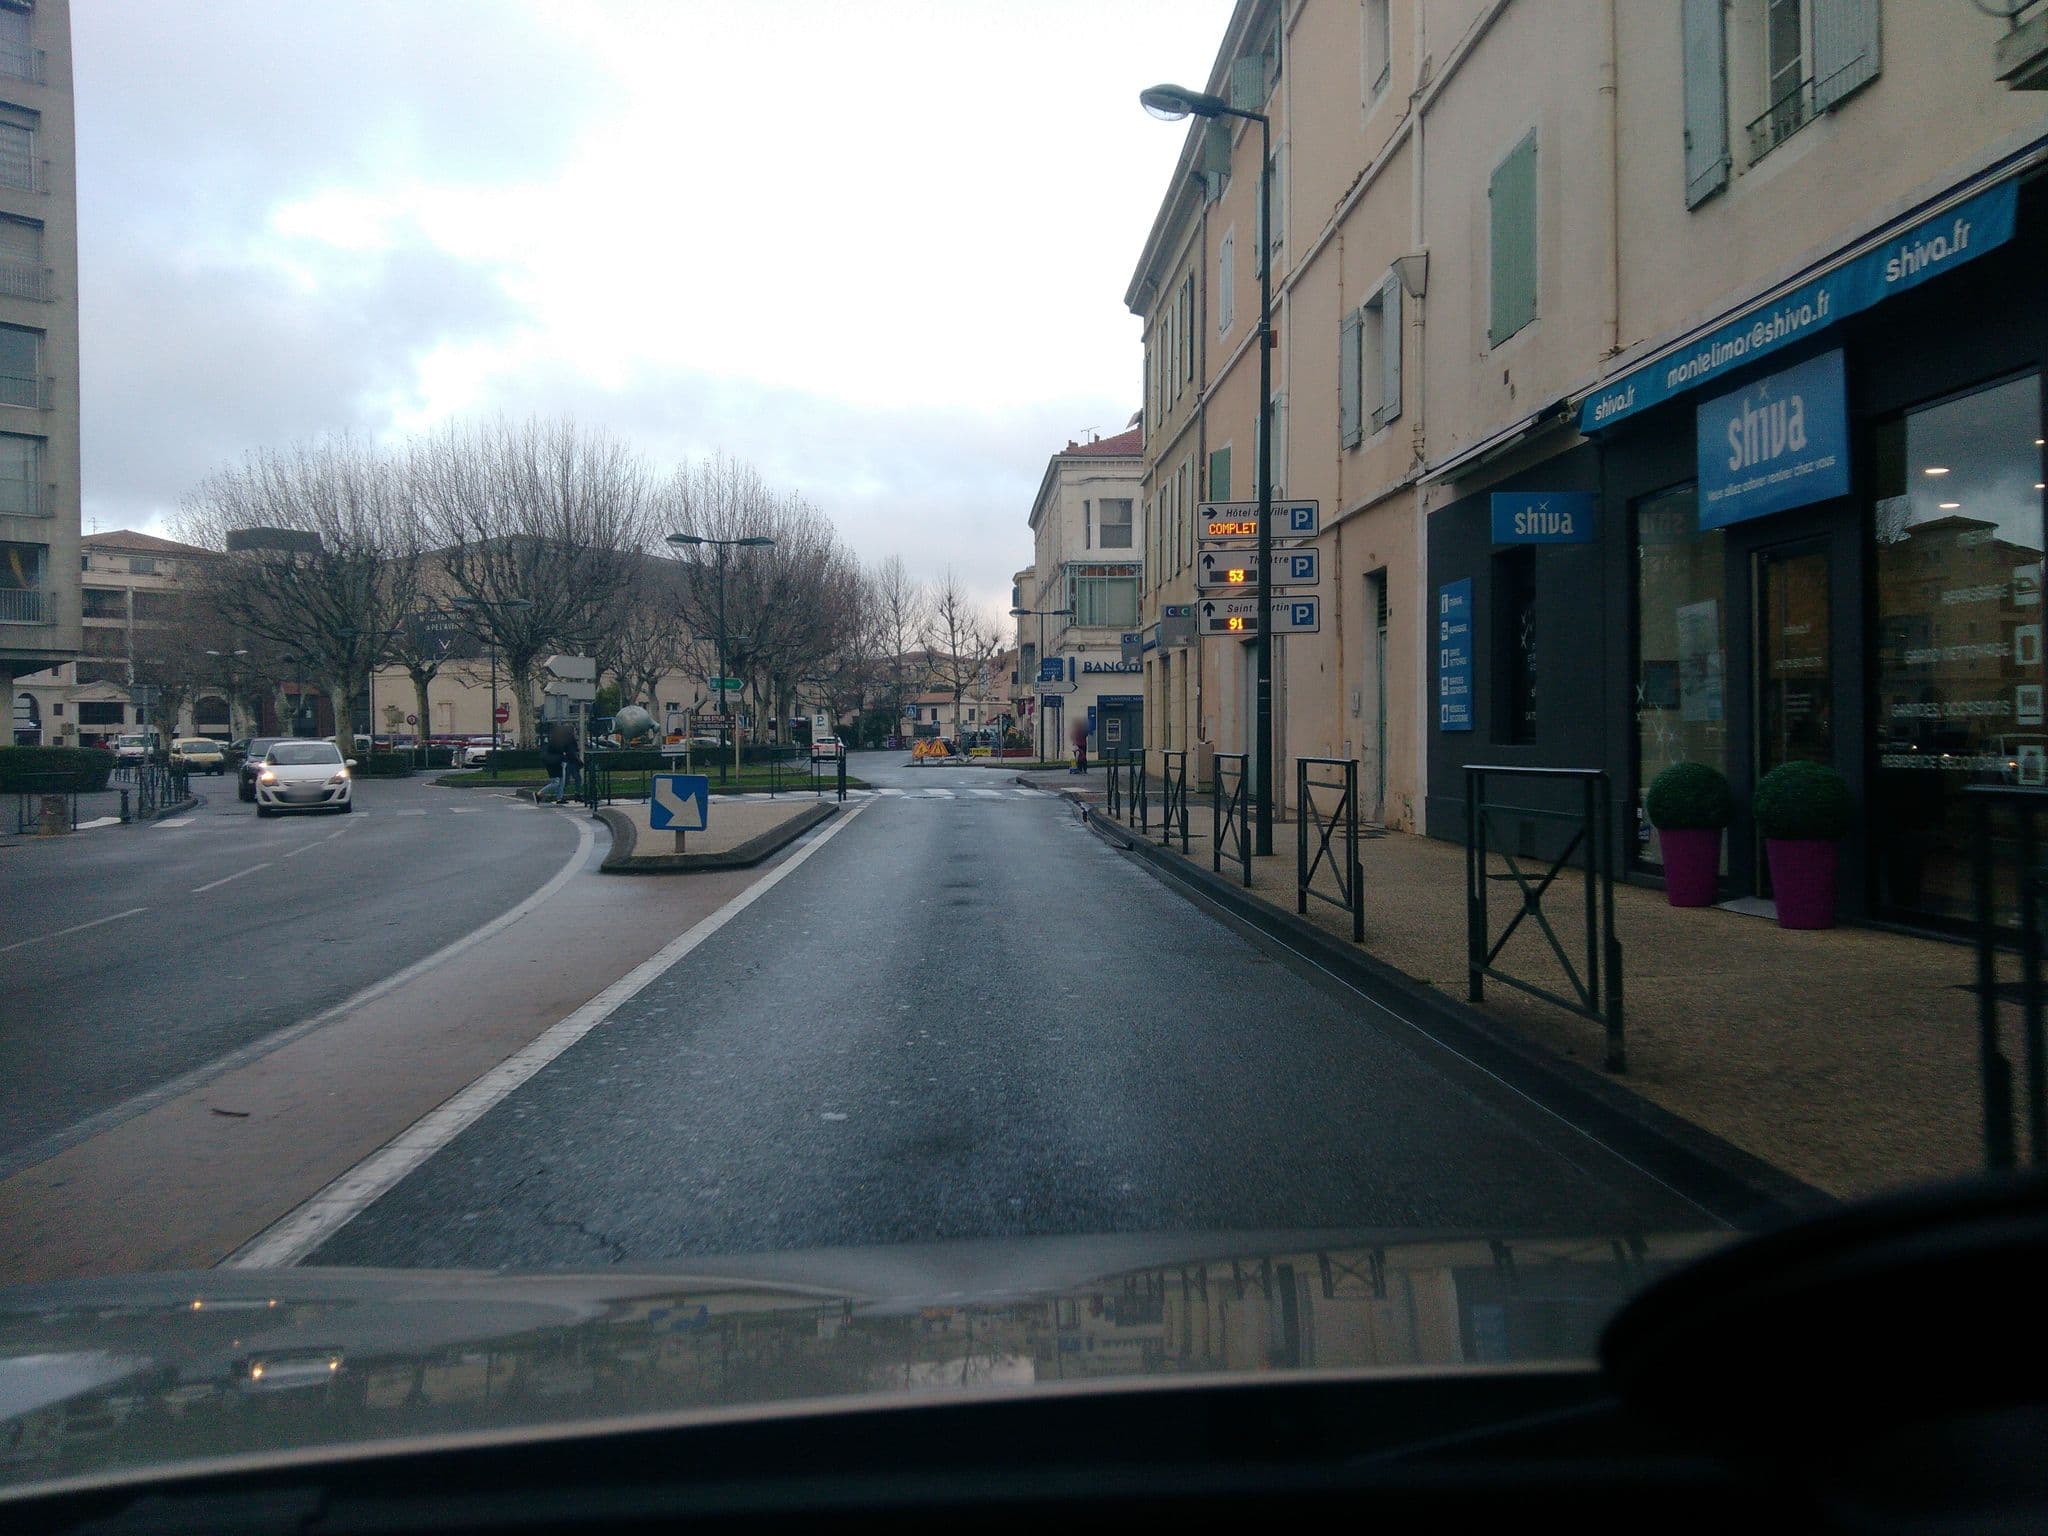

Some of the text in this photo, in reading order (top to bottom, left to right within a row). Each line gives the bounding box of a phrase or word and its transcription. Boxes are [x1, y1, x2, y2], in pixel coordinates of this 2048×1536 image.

[1885, 218, 1971, 282] shiva.fr
[1667, 288, 1831, 388] montelimar@shiva.fr
[1595, 384, 1635, 421] shiva.fr
[1727, 390, 1808, 471] shiva
[1226, 507, 1250, 518] Hôtel
[1295, 510, 1309, 529] P
[1514, 506, 1574, 535] shiva
[1209, 522, 1257, 535] COMPLET
[1249, 555, 1289, 565] Thtre
[1295, 558, 1309, 577] P
[1228, 568, 1245, 582] 53
[1227, 604, 1253, 613] Saint
[1296, 606, 1309, 625] P
[1229, 617, 1244, 630] 91
